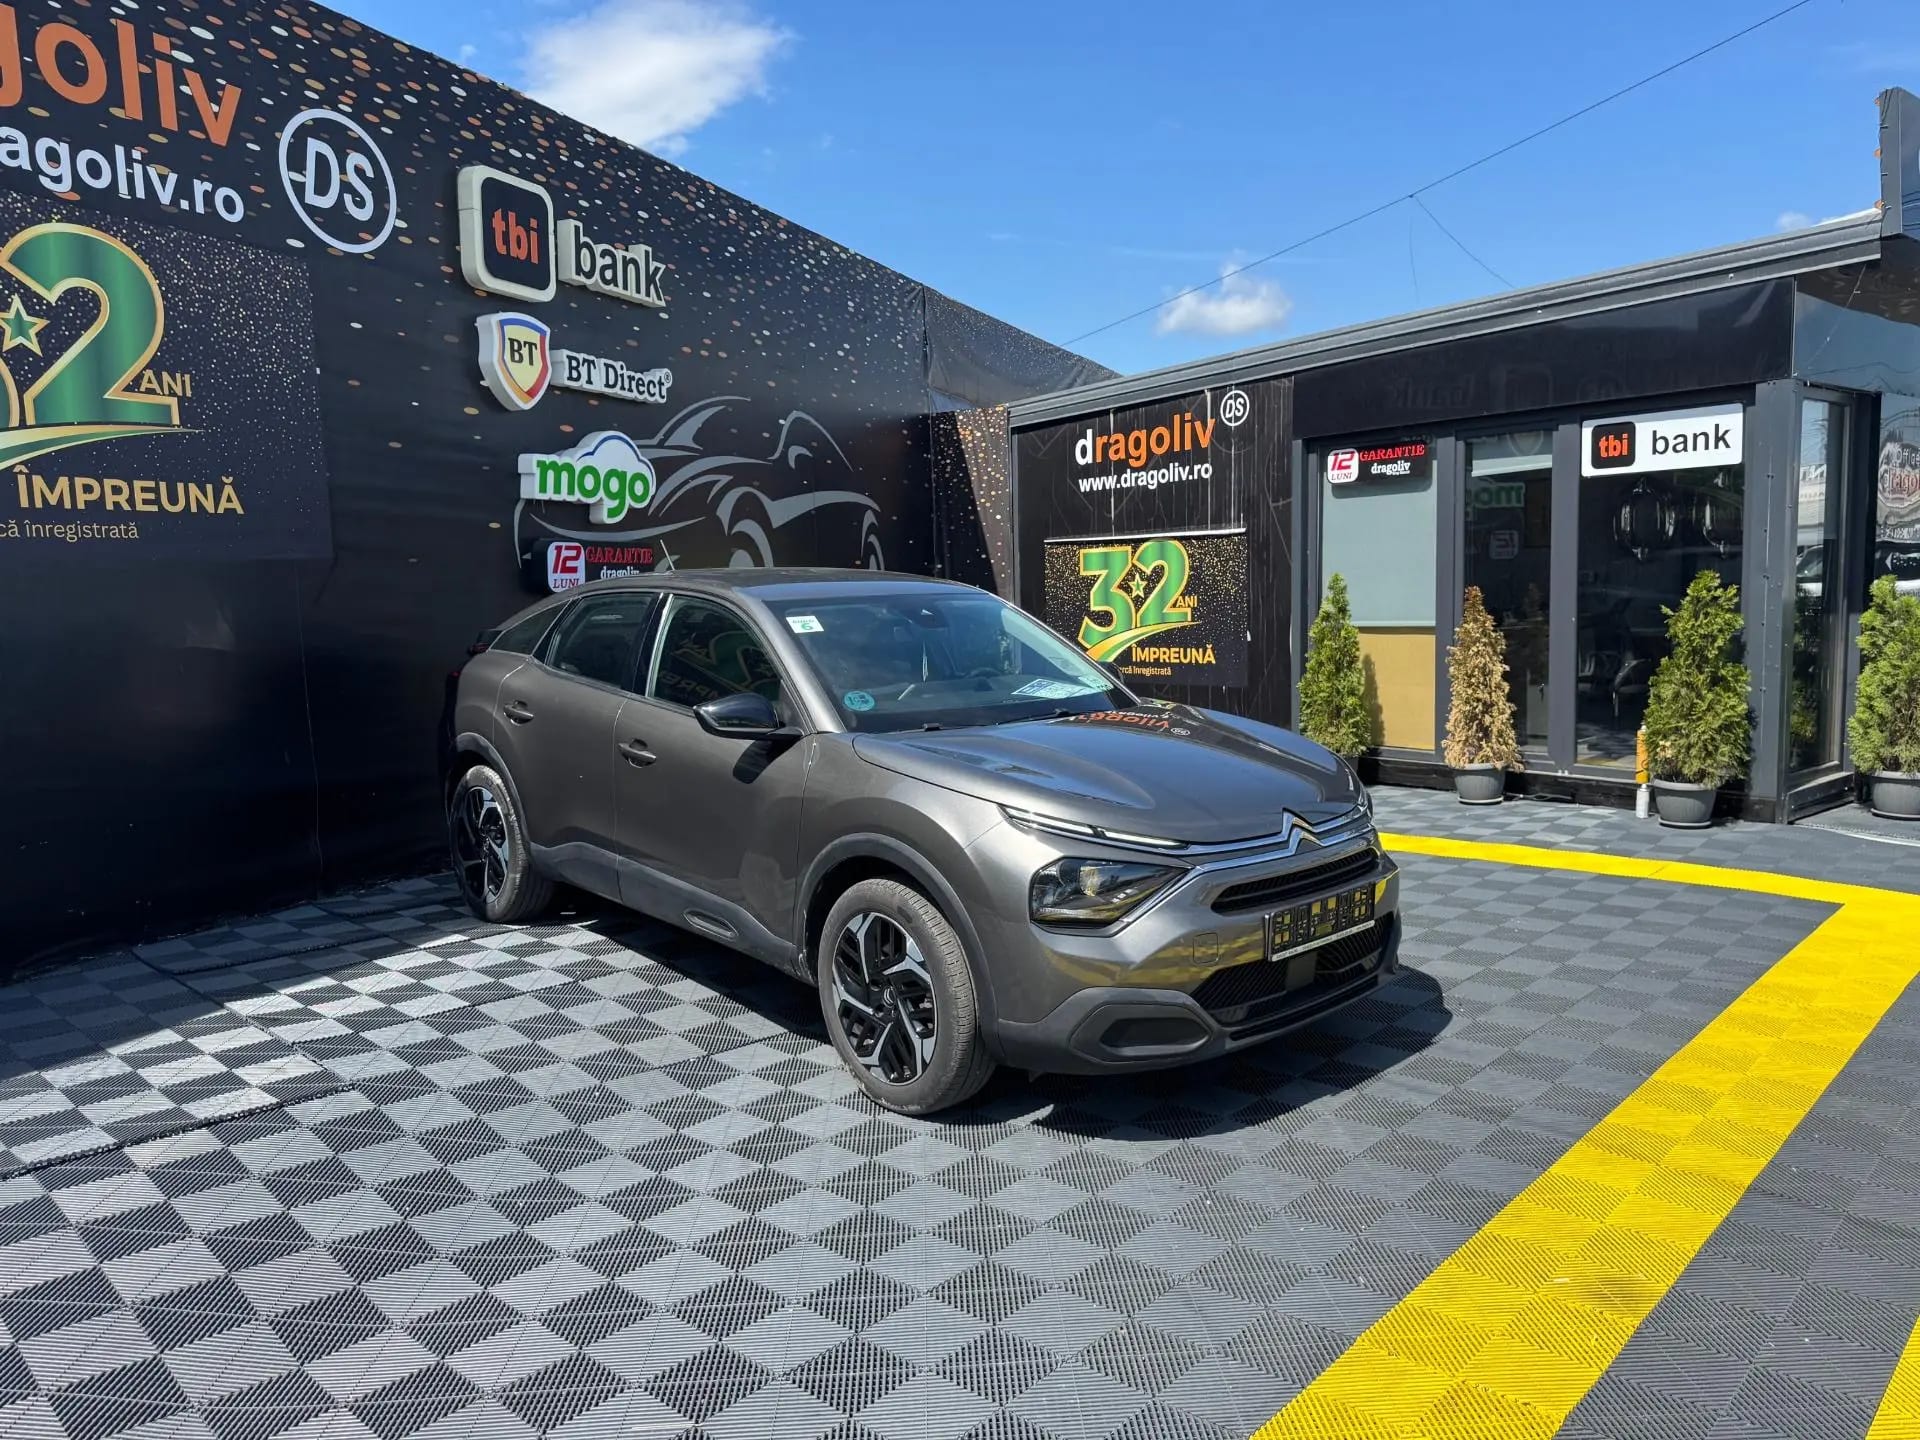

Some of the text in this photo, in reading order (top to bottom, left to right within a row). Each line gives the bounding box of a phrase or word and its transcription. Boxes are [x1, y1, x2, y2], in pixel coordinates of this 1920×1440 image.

[304, 137, 374, 221] DS
[492, 208, 664, 302] tbi bank
[0, 223, 192, 427] 2 ANI
[508, 338, 537, 366] BT
[566, 354, 597, 385] BT
[1225, 396, 1245, 419] DS
[1074, 412, 1216, 468] dragoliv
[1598, 423, 1732, 458] tbi bank
[1330, 444, 1425, 472] 12 GARANTIE
[1371, 460, 1411, 476] dragoliv
[13, 464, 245, 515] ÎMPREUNĂ
[536, 459, 650, 519] mogo
[1078, 462, 1213, 492] www.dragoliv.ro
[1331, 472, 1352, 481] LUNI
[24, 519, 139, 542] înregistrată
[552, 545, 654, 575] 12 GARANTIE
[1078, 539, 1198, 648] 32 ANI
[1131, 644, 1216, 665] ÎMPREUNĂ
